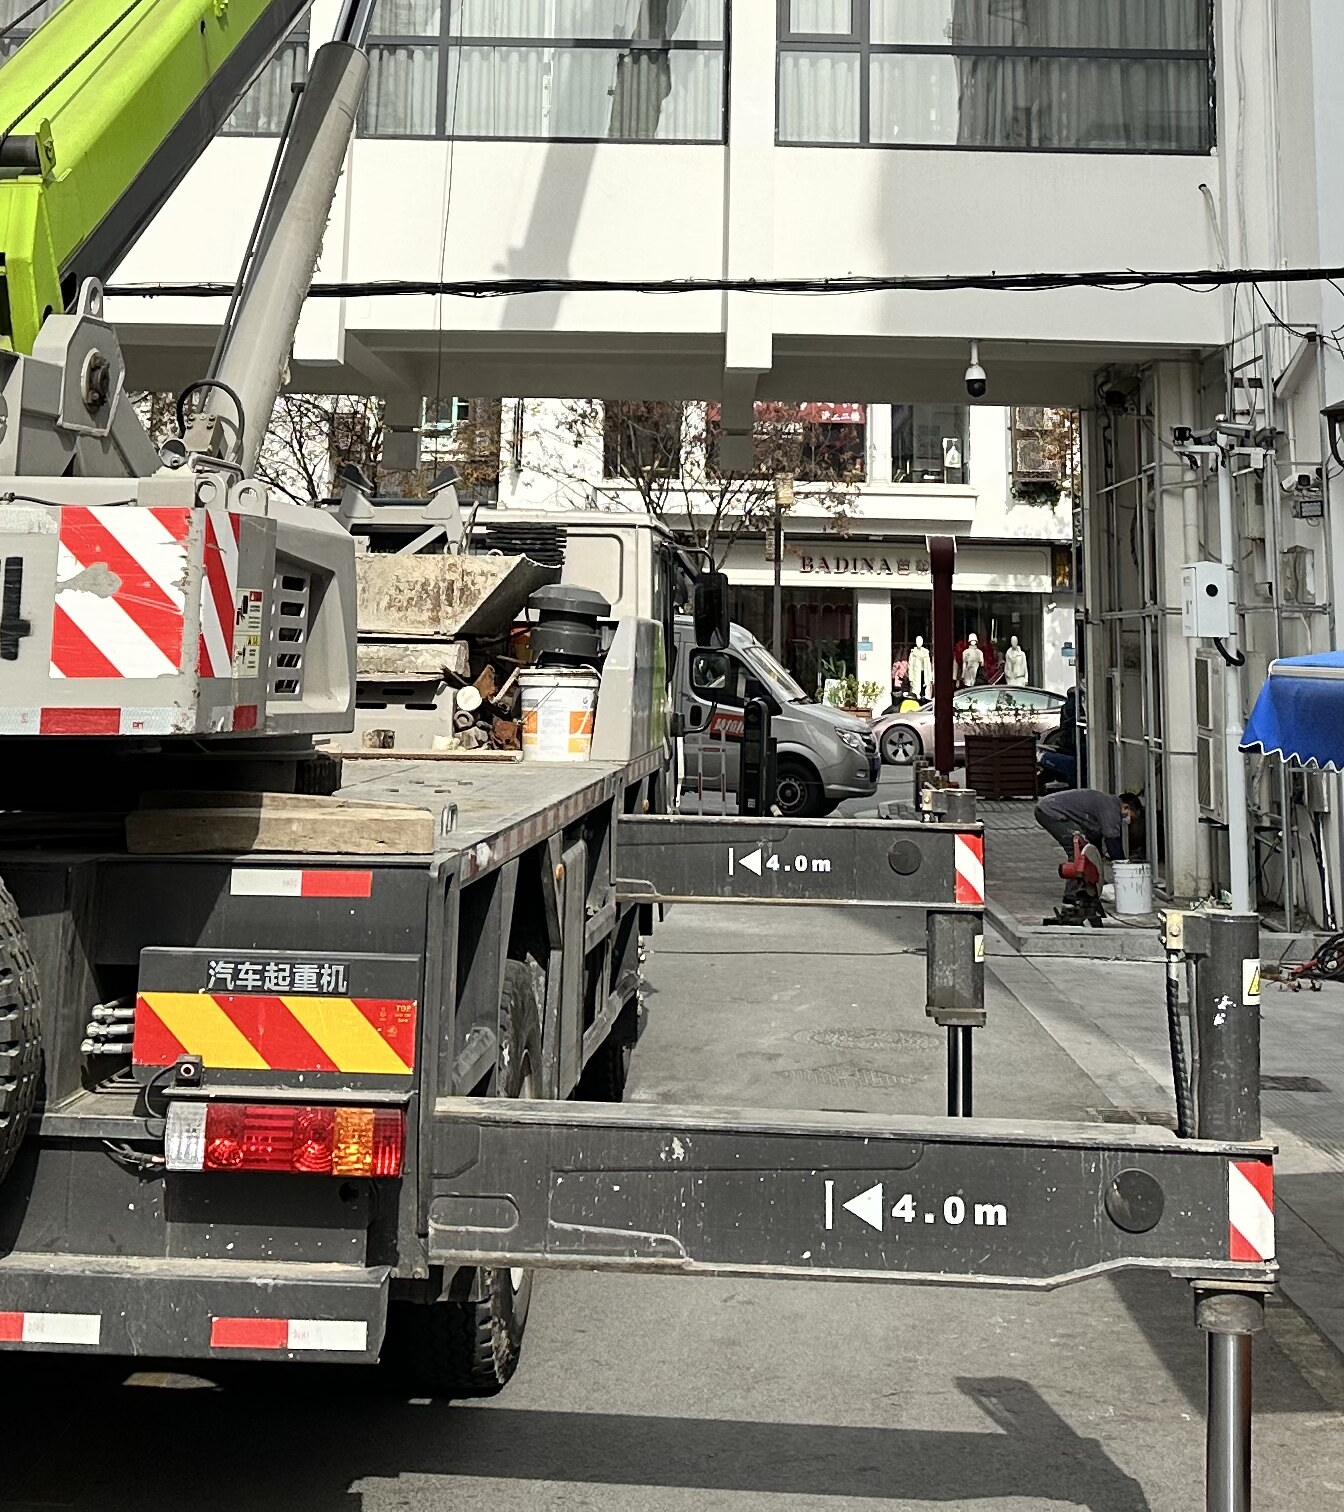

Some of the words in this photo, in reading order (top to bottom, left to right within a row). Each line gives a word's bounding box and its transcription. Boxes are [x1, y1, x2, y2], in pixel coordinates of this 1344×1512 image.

[800, 556, 894, 575] BADINA
[207, 960, 347, 993] 汽车起重机
